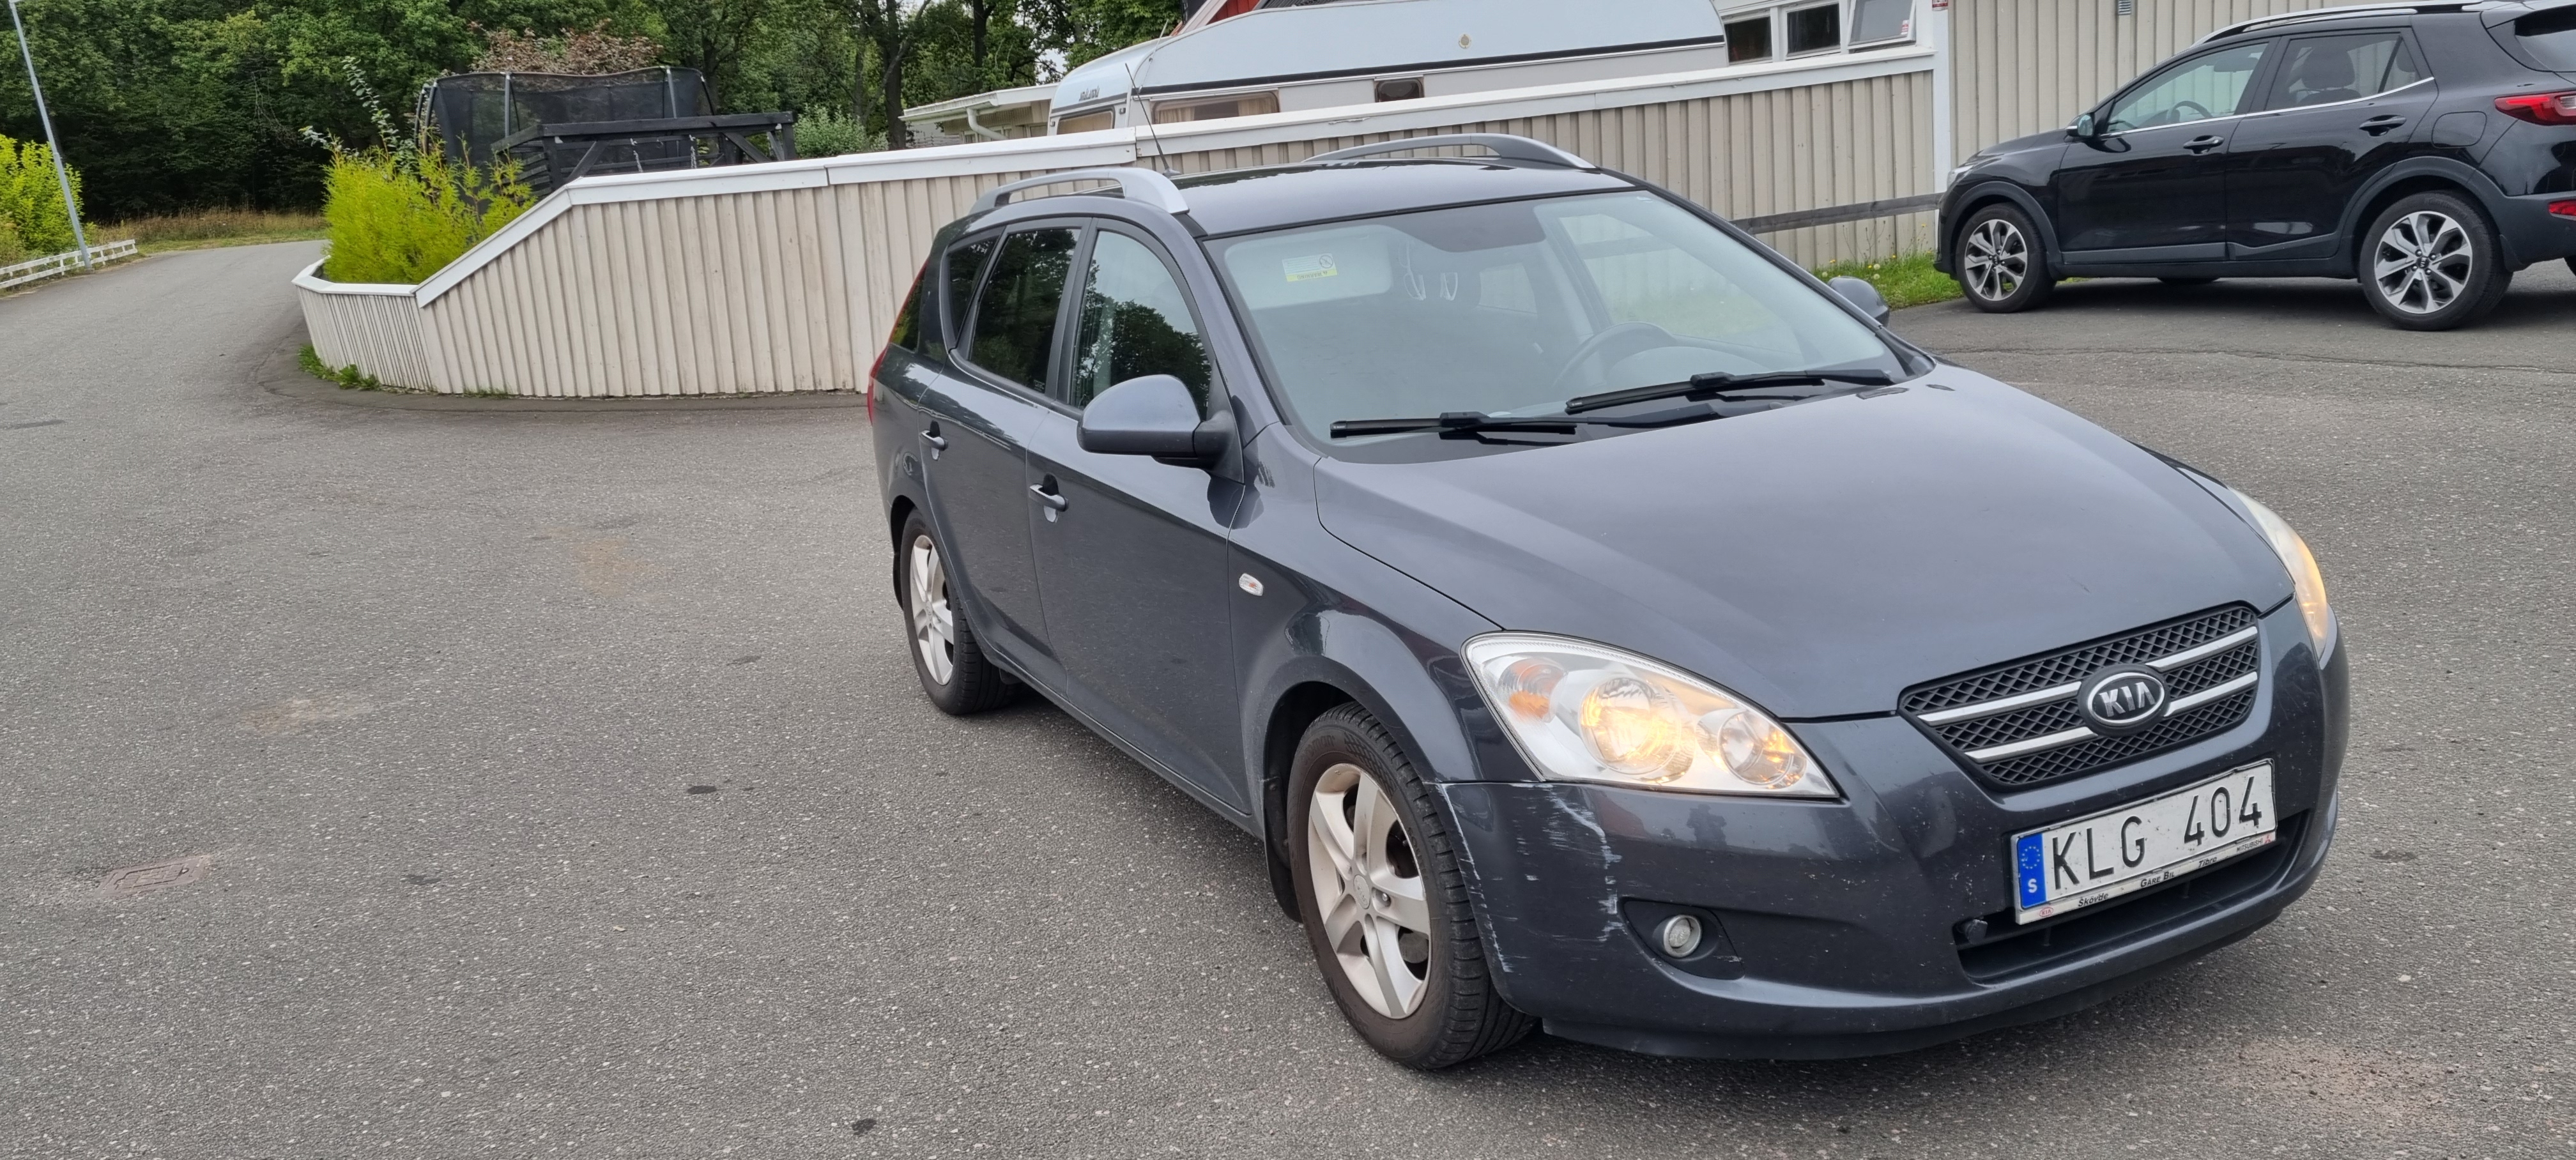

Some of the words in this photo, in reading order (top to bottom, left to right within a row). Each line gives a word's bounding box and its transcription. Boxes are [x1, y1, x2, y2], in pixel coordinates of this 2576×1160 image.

[2098, 681, 2156, 717] KIA
[2051, 815, 2146, 890] KLG
[2183, 776, 2262, 846] 404
[2027, 878, 2038, 894] S
[2078, 893, 2109, 907] Skövde
[2198, 857, 2218, 868] Tibro
[2236, 838, 2264, 853] MITSUBISHI
